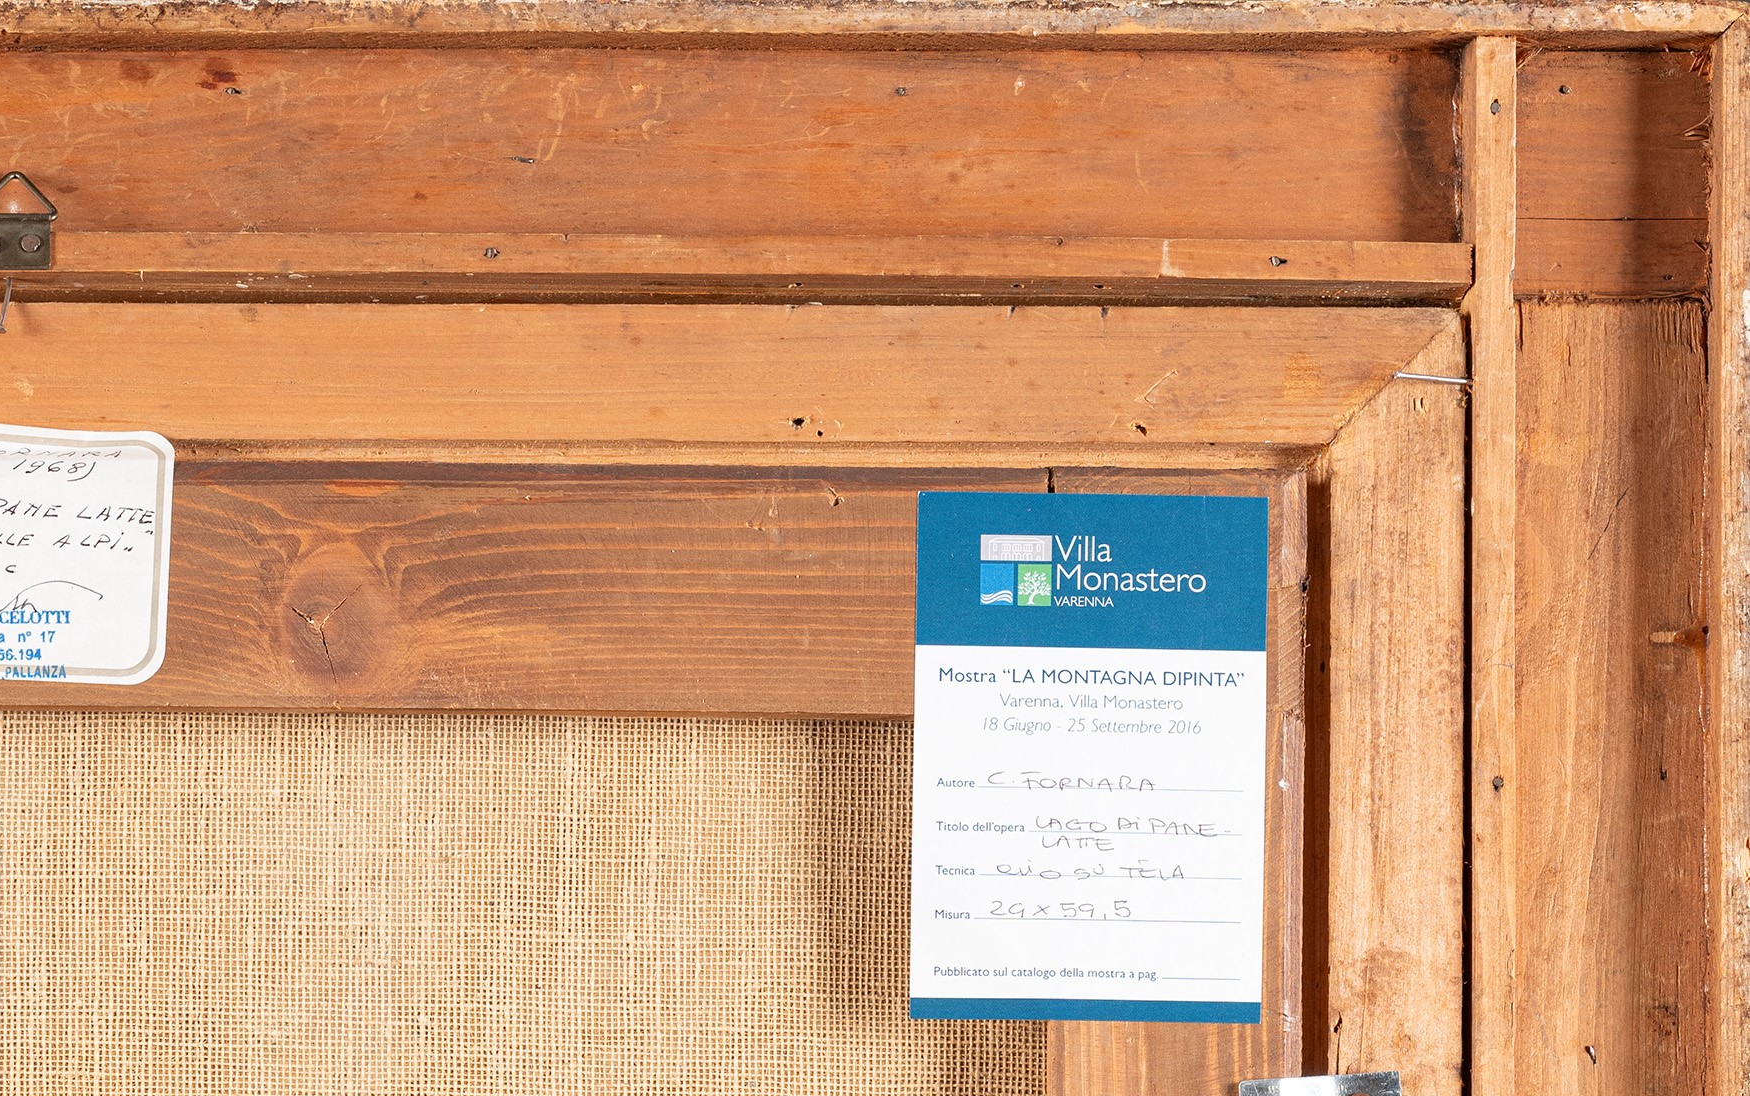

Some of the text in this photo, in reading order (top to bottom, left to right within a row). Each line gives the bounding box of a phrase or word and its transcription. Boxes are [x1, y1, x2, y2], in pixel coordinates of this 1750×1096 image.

[1054, 535, 1112, 562] Villa
[1055, 563, 1207, 593] Monastero
[1053, 595, 1114, 608] VARENNA
[40, 631, 56, 643] 17
[939, 667, 997, 683] Mostra
[1041, 669, 1157, 686] MONTAGNA
[999, 693, 1184, 710] Varenna, Villa Monastero
[982, 716, 998, 731] 18
[1003, 717, 1052, 736] Giugno
[1067, 717, 1086, 732] 25
[1091, 718, 1162, 735] Settembre
[1167, 719, 1202, 735] 2016
[936, 778, 976, 789] Autore
[1020, 771, 1156, 792] FORNARA
[936, 820, 1026, 836] Titolo dell'opera
[1035, 815, 1108, 834] LAGO
[1041, 835, 1115, 852] LATTE
[935, 865, 976, 877] Tecnica
[934, 909, 971, 921] Misura
[933, 966, 1160, 983] Pubblicato sul catalogo della mostra a pag.
